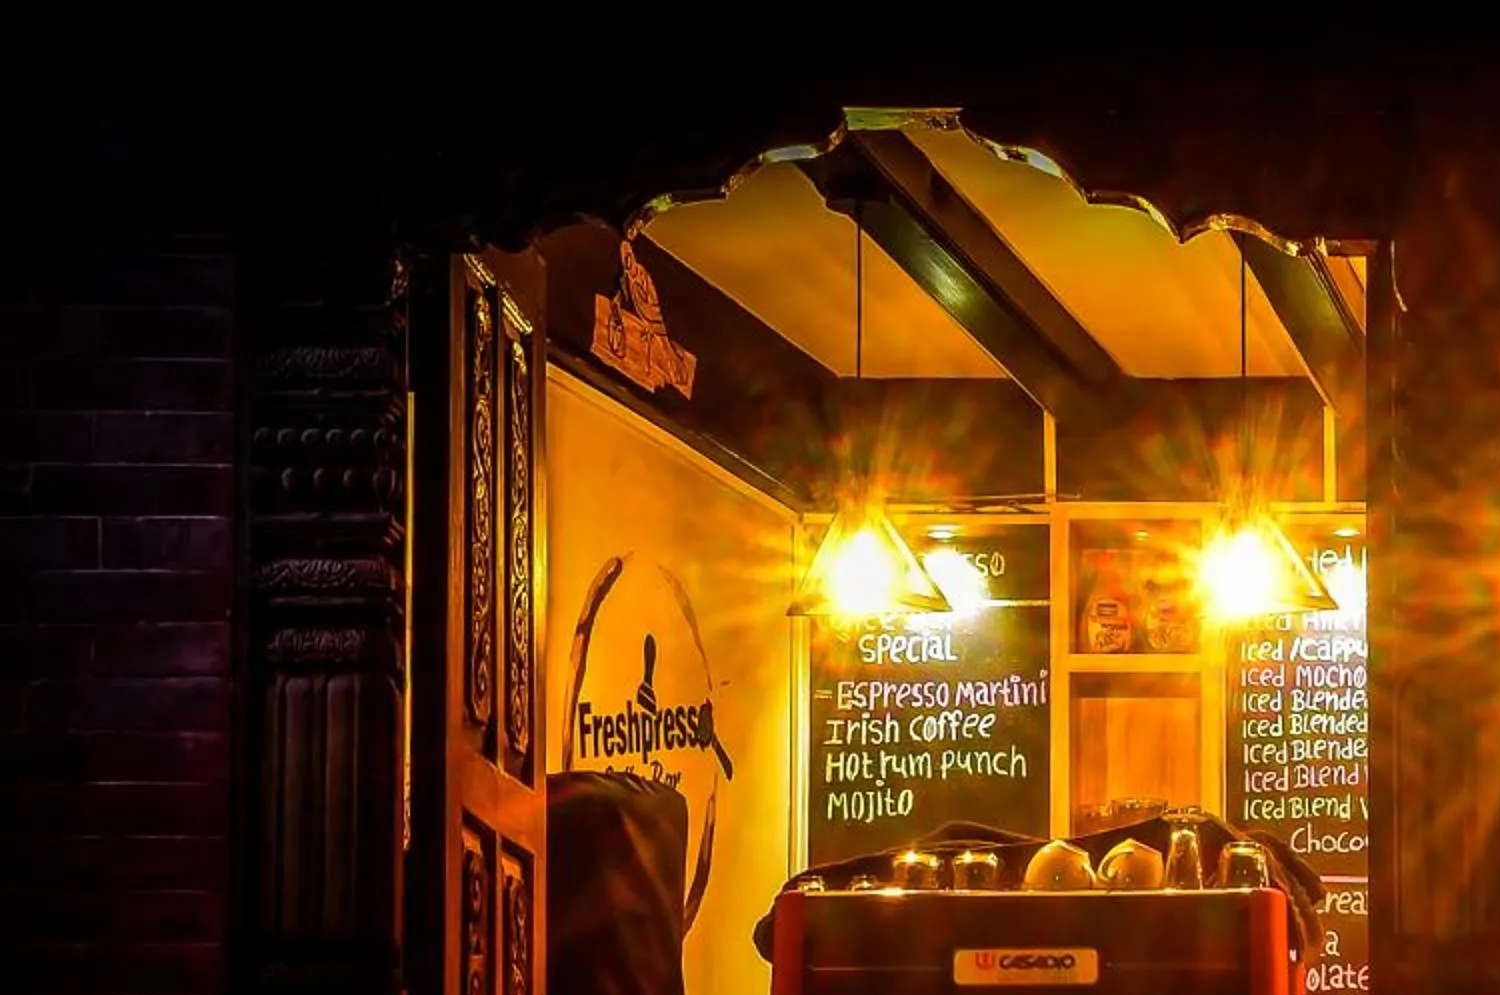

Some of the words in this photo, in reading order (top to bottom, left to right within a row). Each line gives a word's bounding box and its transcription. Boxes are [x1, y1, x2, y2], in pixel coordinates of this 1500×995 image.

[837, 680, 949, 711] Espresso
[954, 668, 1049, 710] Martini
[1290, 687, 1368, 712] Blende
[578, 698, 714, 765] Freshpresso
[823, 711, 900, 746] Irish
[824, 750, 874, 784] Hot
[879, 749, 933, 780] rum
[940, 743, 1028, 781] punch
[1290, 736, 1369, 762] Blende
[1293, 763, 1359, 790] Blend
[826, 779, 915, 824] Mojito
[1288, 792, 1351, 820] Blend
[1289, 821, 1369, 855] Choco
